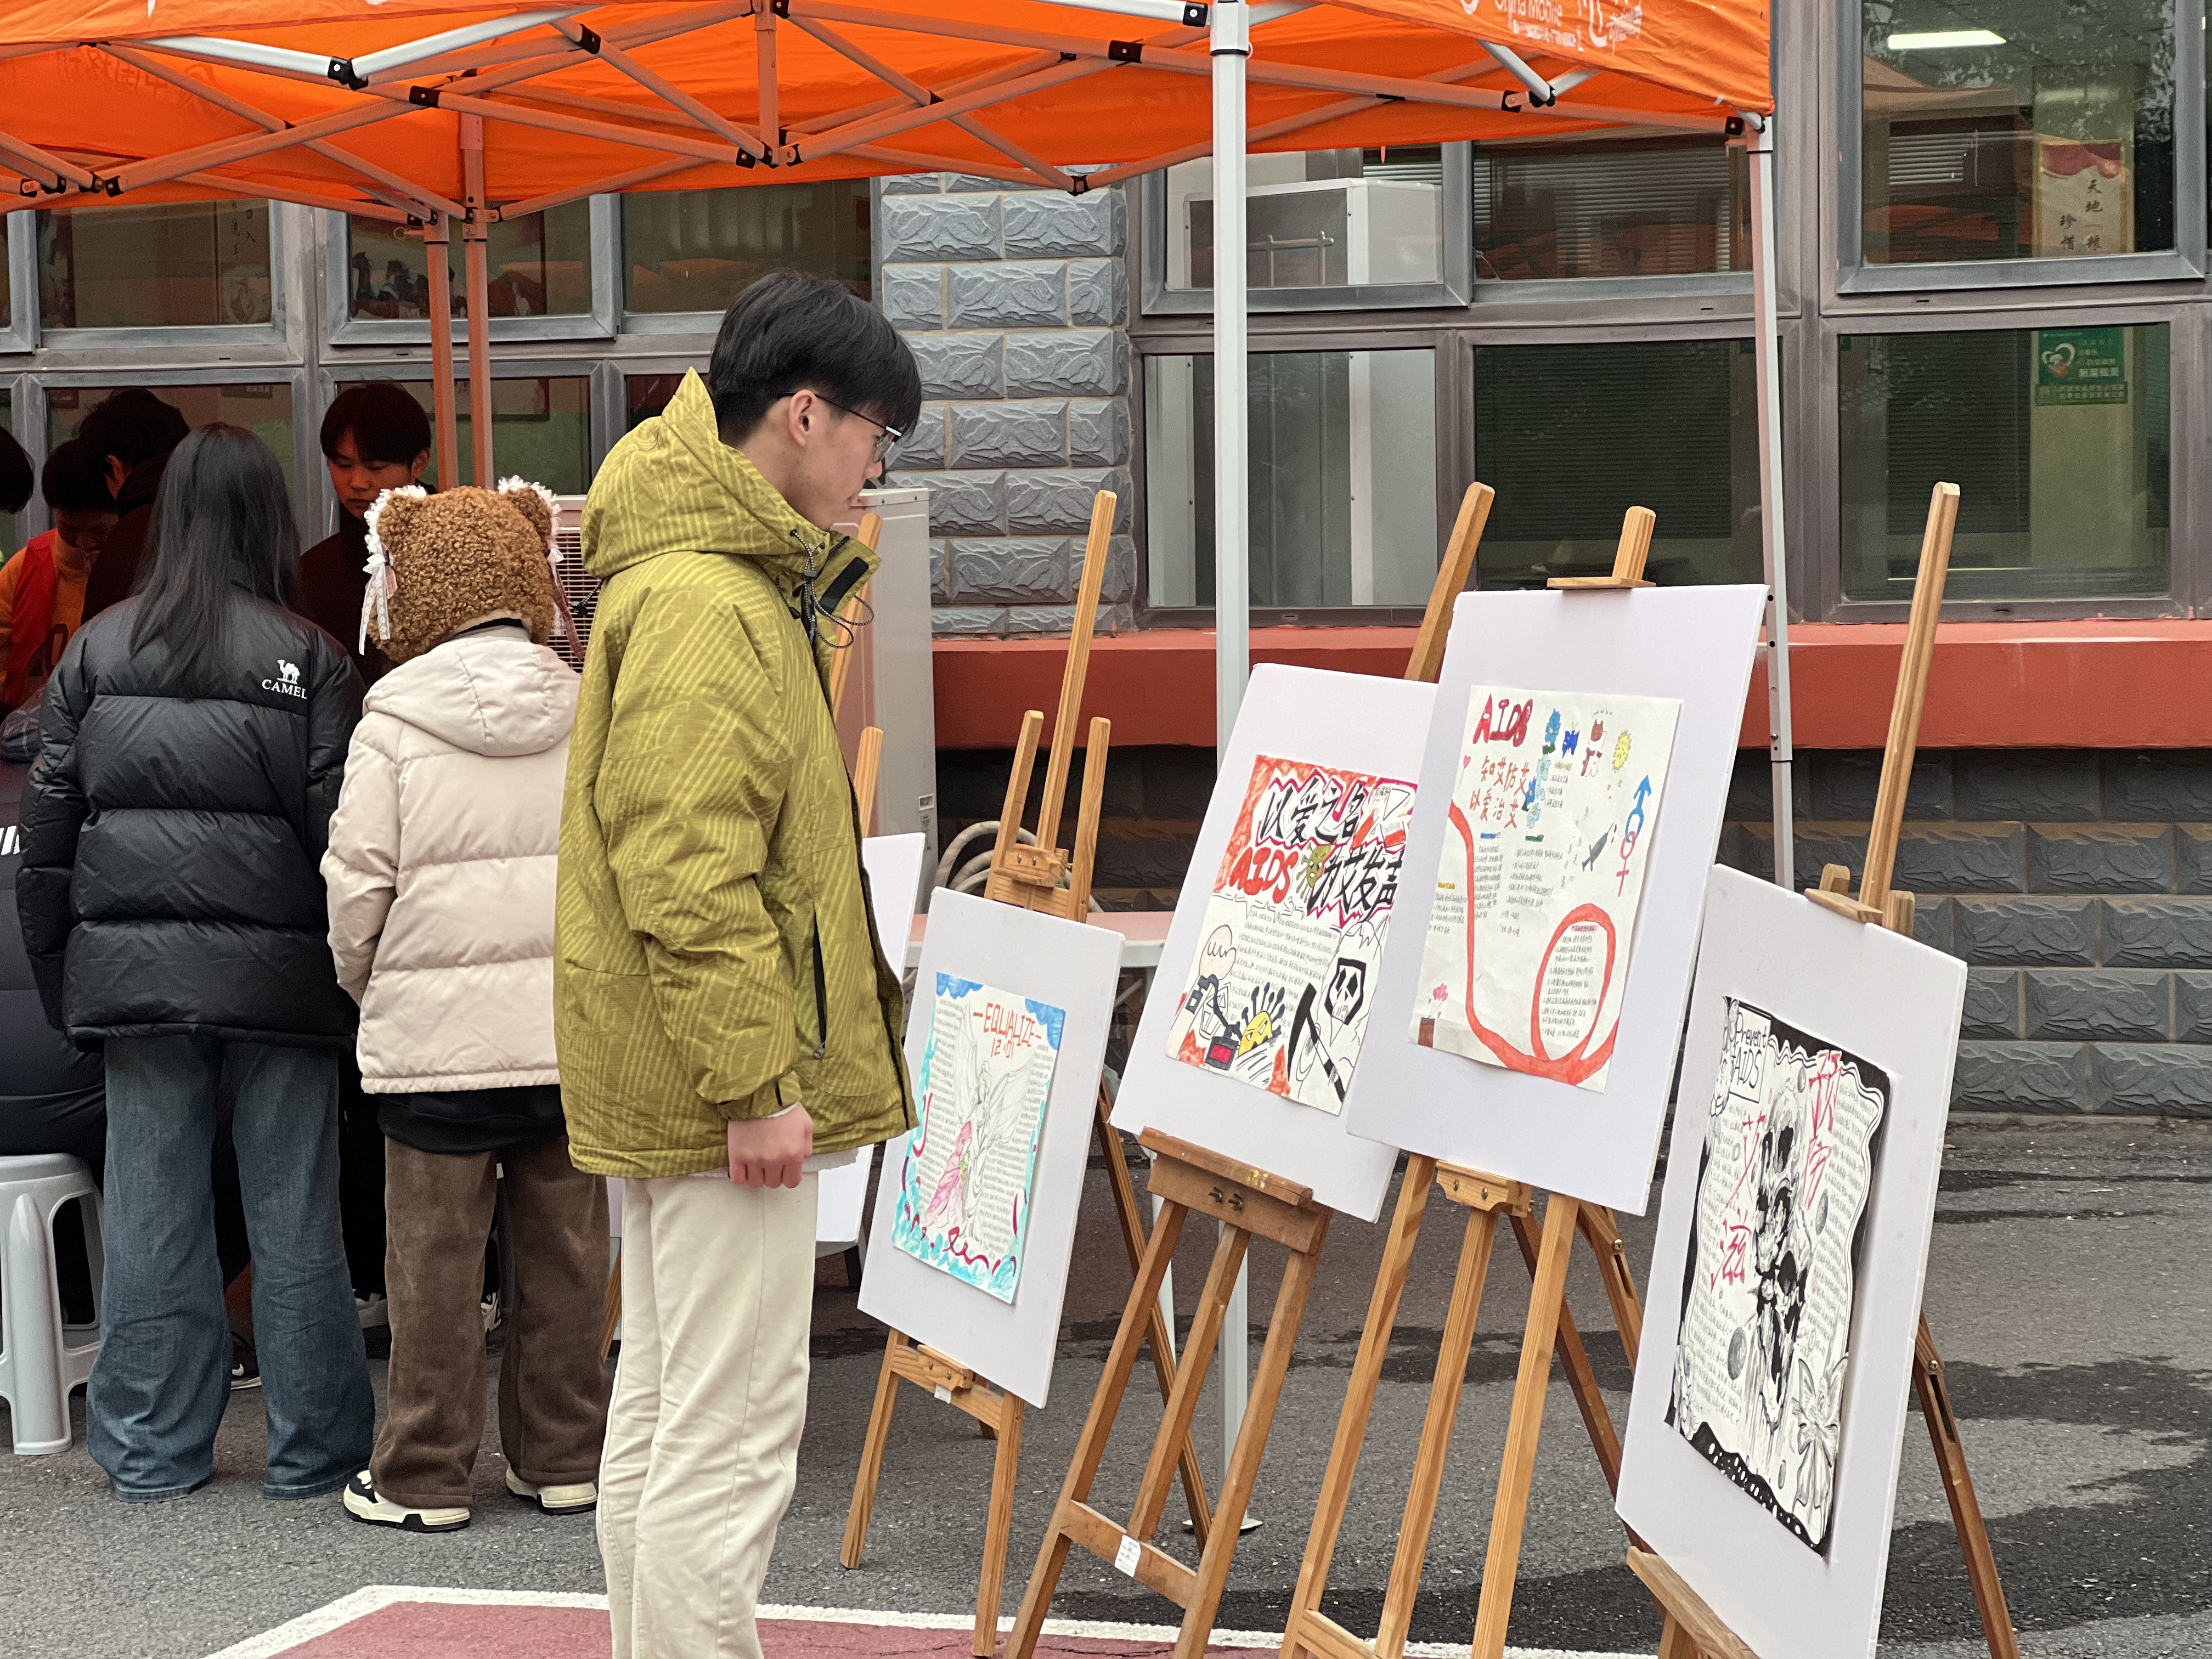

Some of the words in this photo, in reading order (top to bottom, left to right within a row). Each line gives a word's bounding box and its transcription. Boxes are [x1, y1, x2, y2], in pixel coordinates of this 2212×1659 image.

[262, 679, 307, 699] CAMEL
[1260, 777, 1365, 844] 以爱之名
[1229, 847, 1299, 904] AIDS
[1734, 1012, 1767, 1048] Prevent
[1731, 1046, 1762, 1089] AIDS
